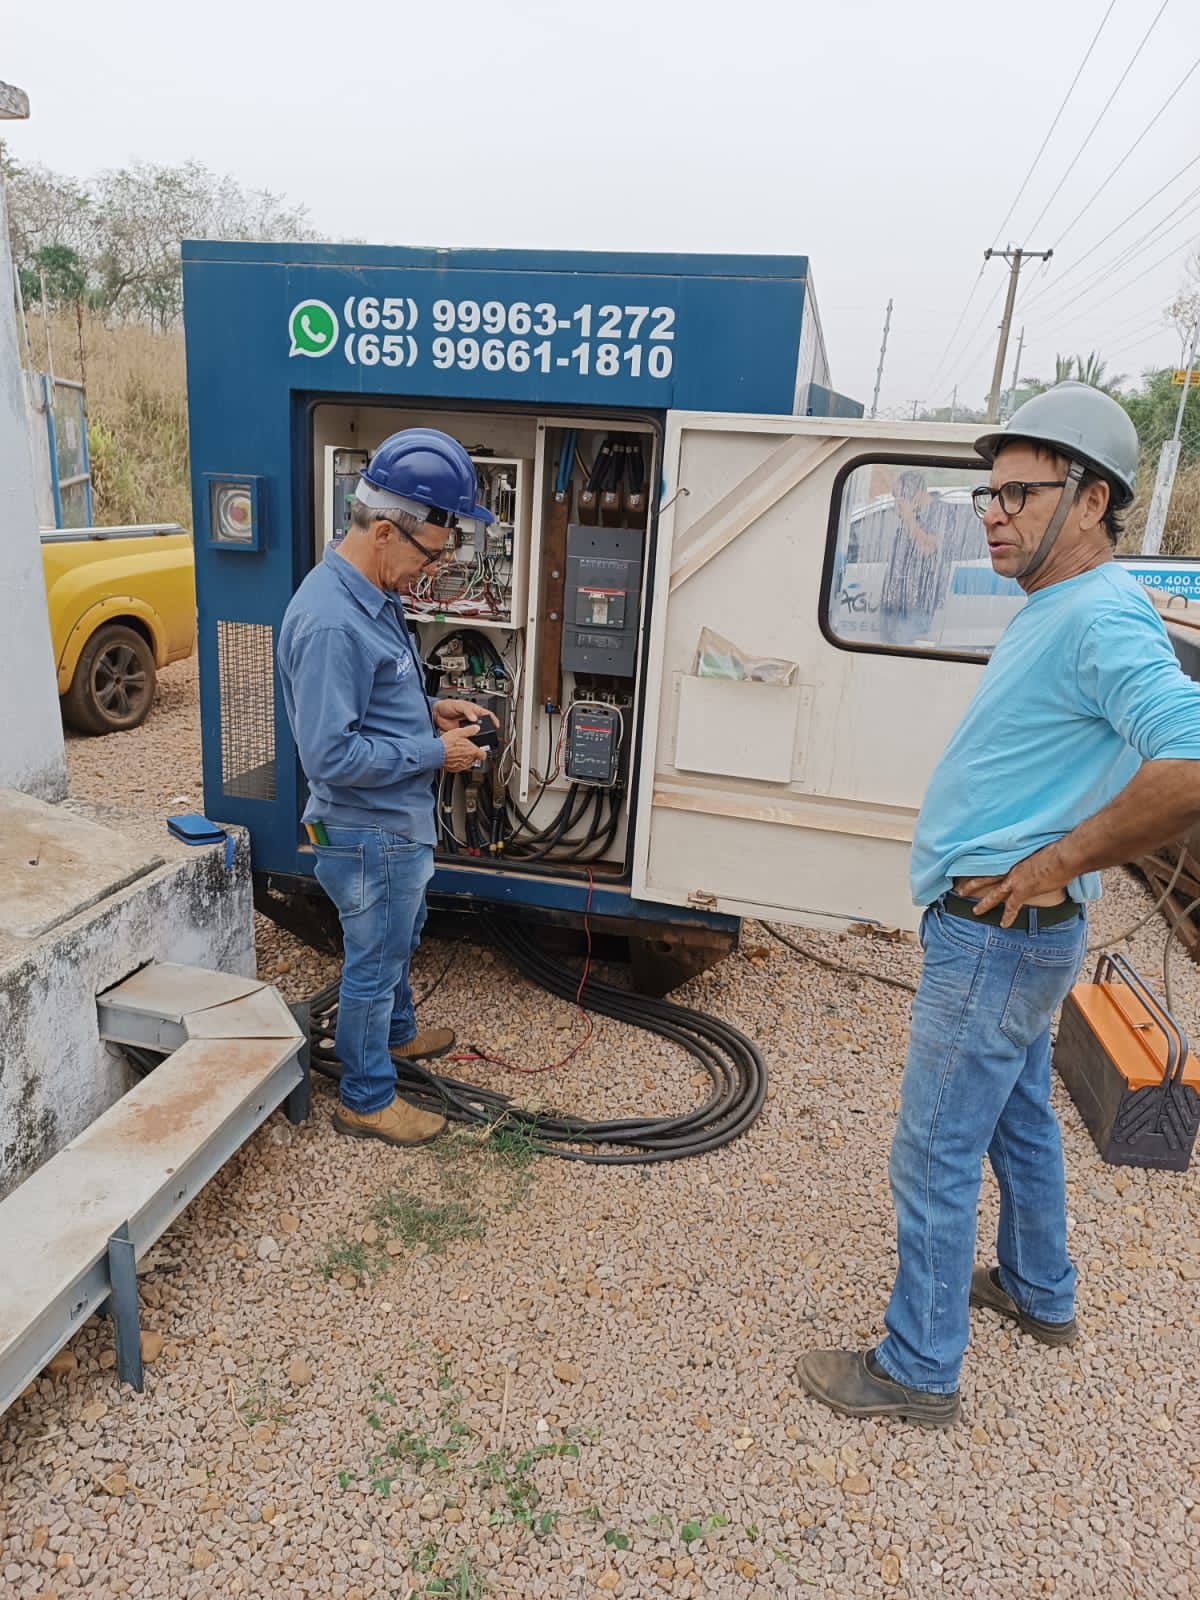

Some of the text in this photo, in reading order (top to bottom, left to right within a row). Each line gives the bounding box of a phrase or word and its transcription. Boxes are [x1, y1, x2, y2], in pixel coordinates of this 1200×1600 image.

[344, 296, 676, 340] (65) 99963-1272
[344, 333, 673, 379] (65) 99661-1810
[1136, 575, 1161, 585] 800
[1165, 575, 1191, 586] 400
